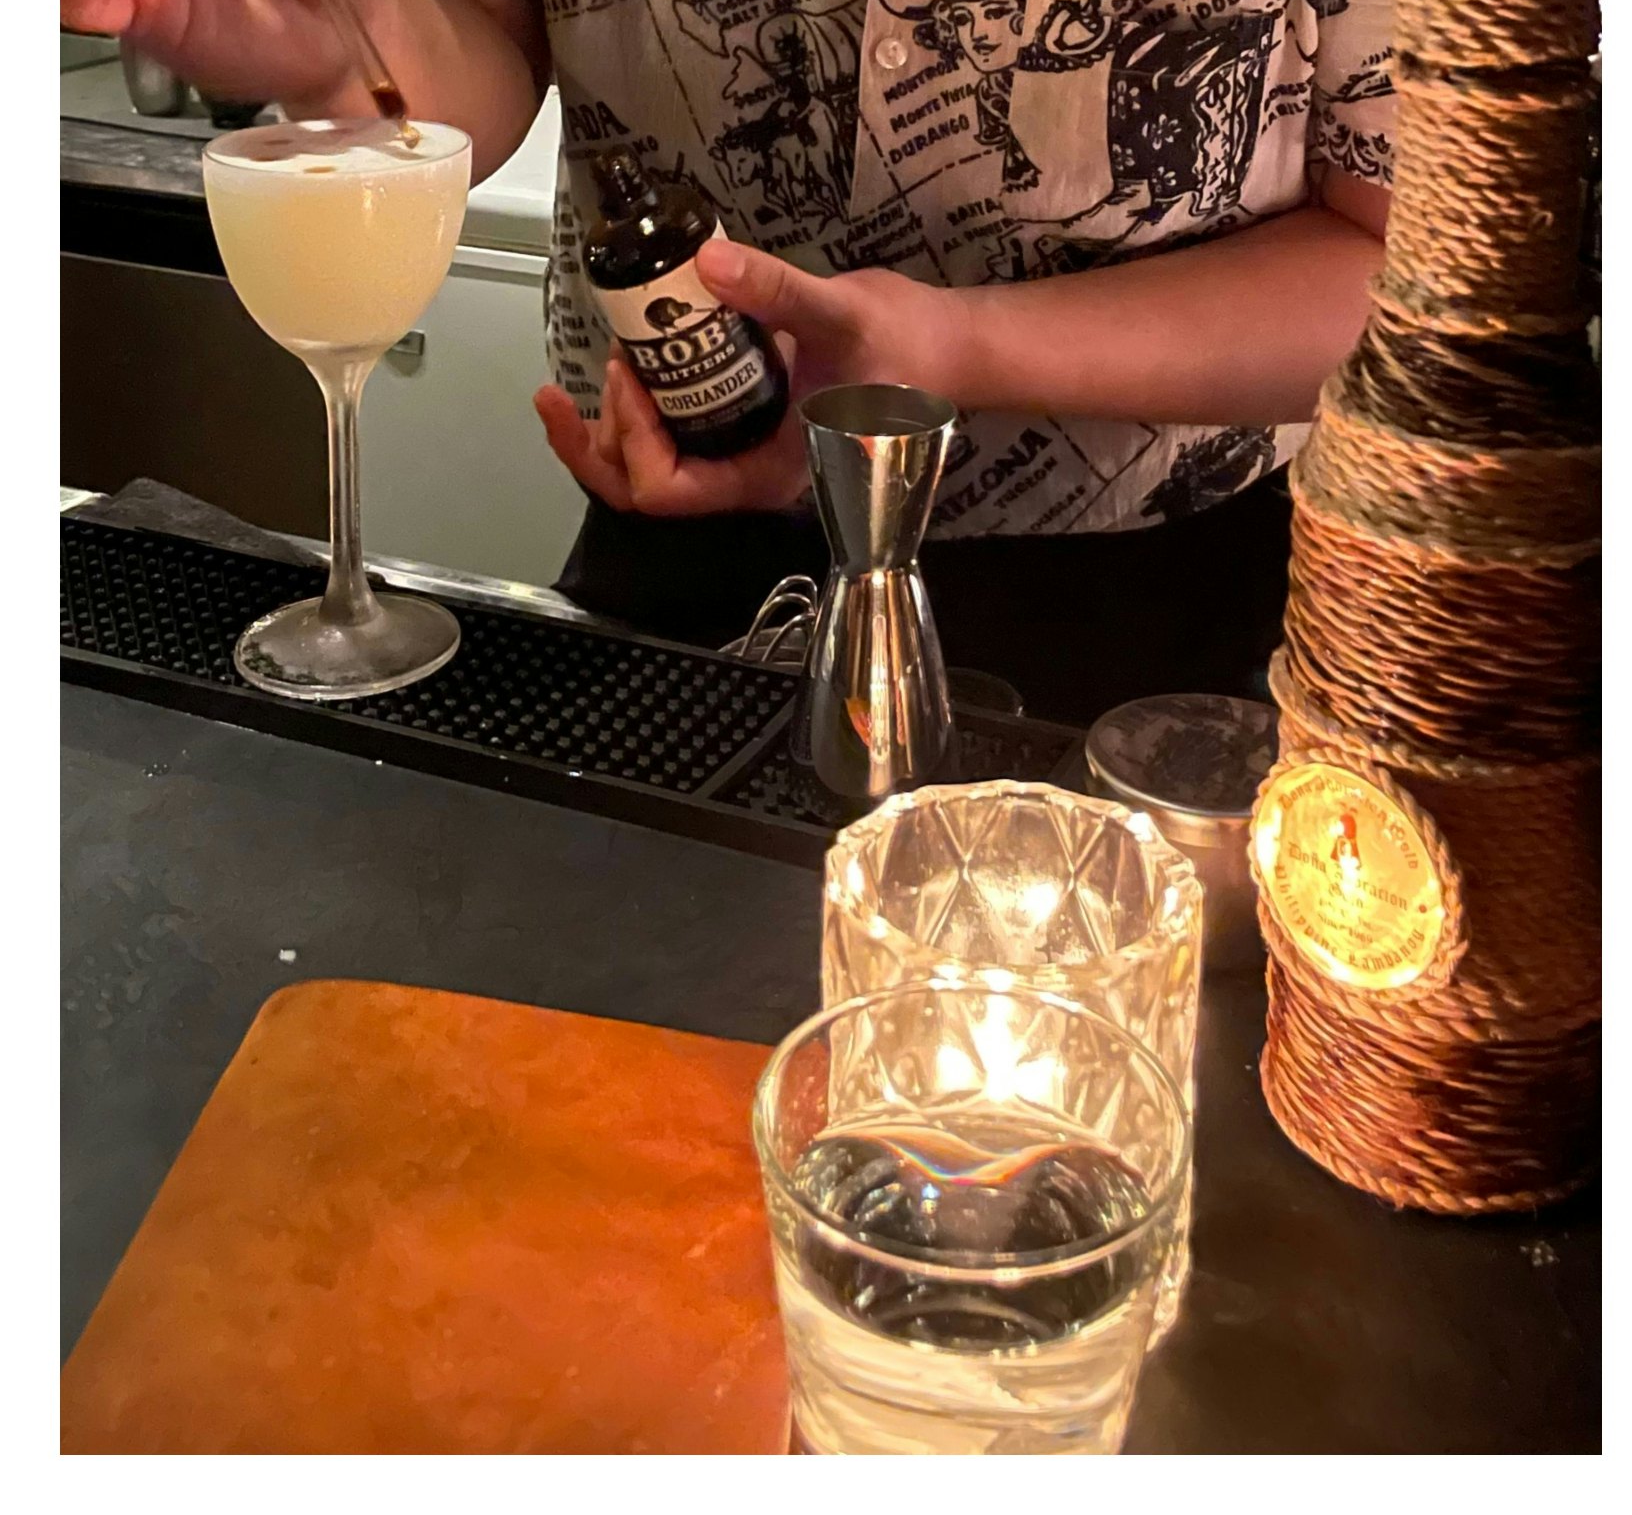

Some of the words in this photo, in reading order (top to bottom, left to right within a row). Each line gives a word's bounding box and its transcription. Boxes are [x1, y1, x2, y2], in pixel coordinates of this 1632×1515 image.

[566, 100, 631, 143] ADA
[888, 113, 970, 165] DURANGO
[658, 342, 736, 383] BITTERS
[661, 361, 759, 411] CORIANDER
